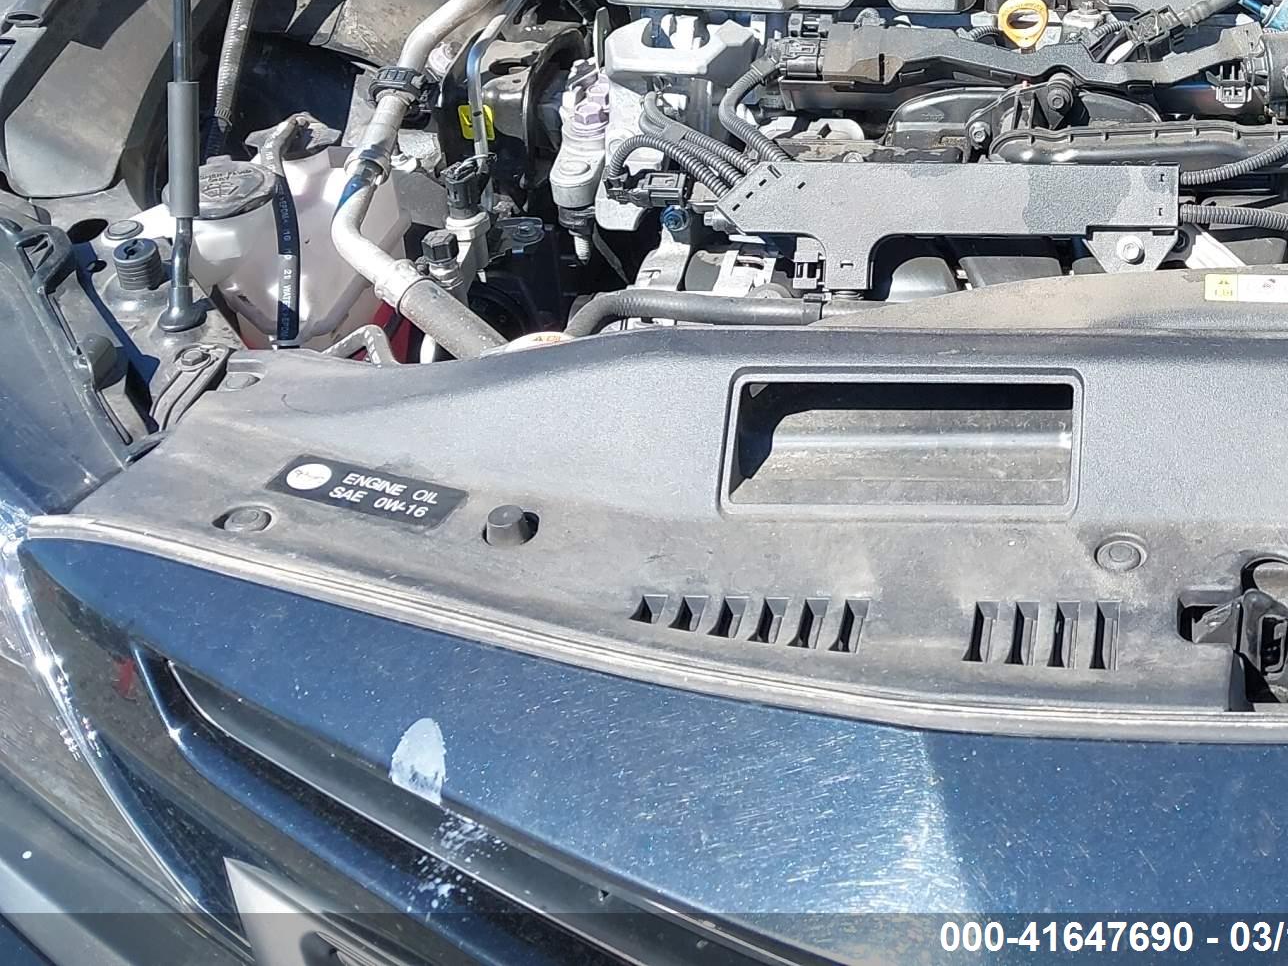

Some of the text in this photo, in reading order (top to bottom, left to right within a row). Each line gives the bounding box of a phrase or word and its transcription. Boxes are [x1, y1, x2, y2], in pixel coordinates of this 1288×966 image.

[329, 487, 428, 517] SAE 0W-16
[343, 473, 408, 496] ENGINE
[412, 490, 438, 504] OIL
